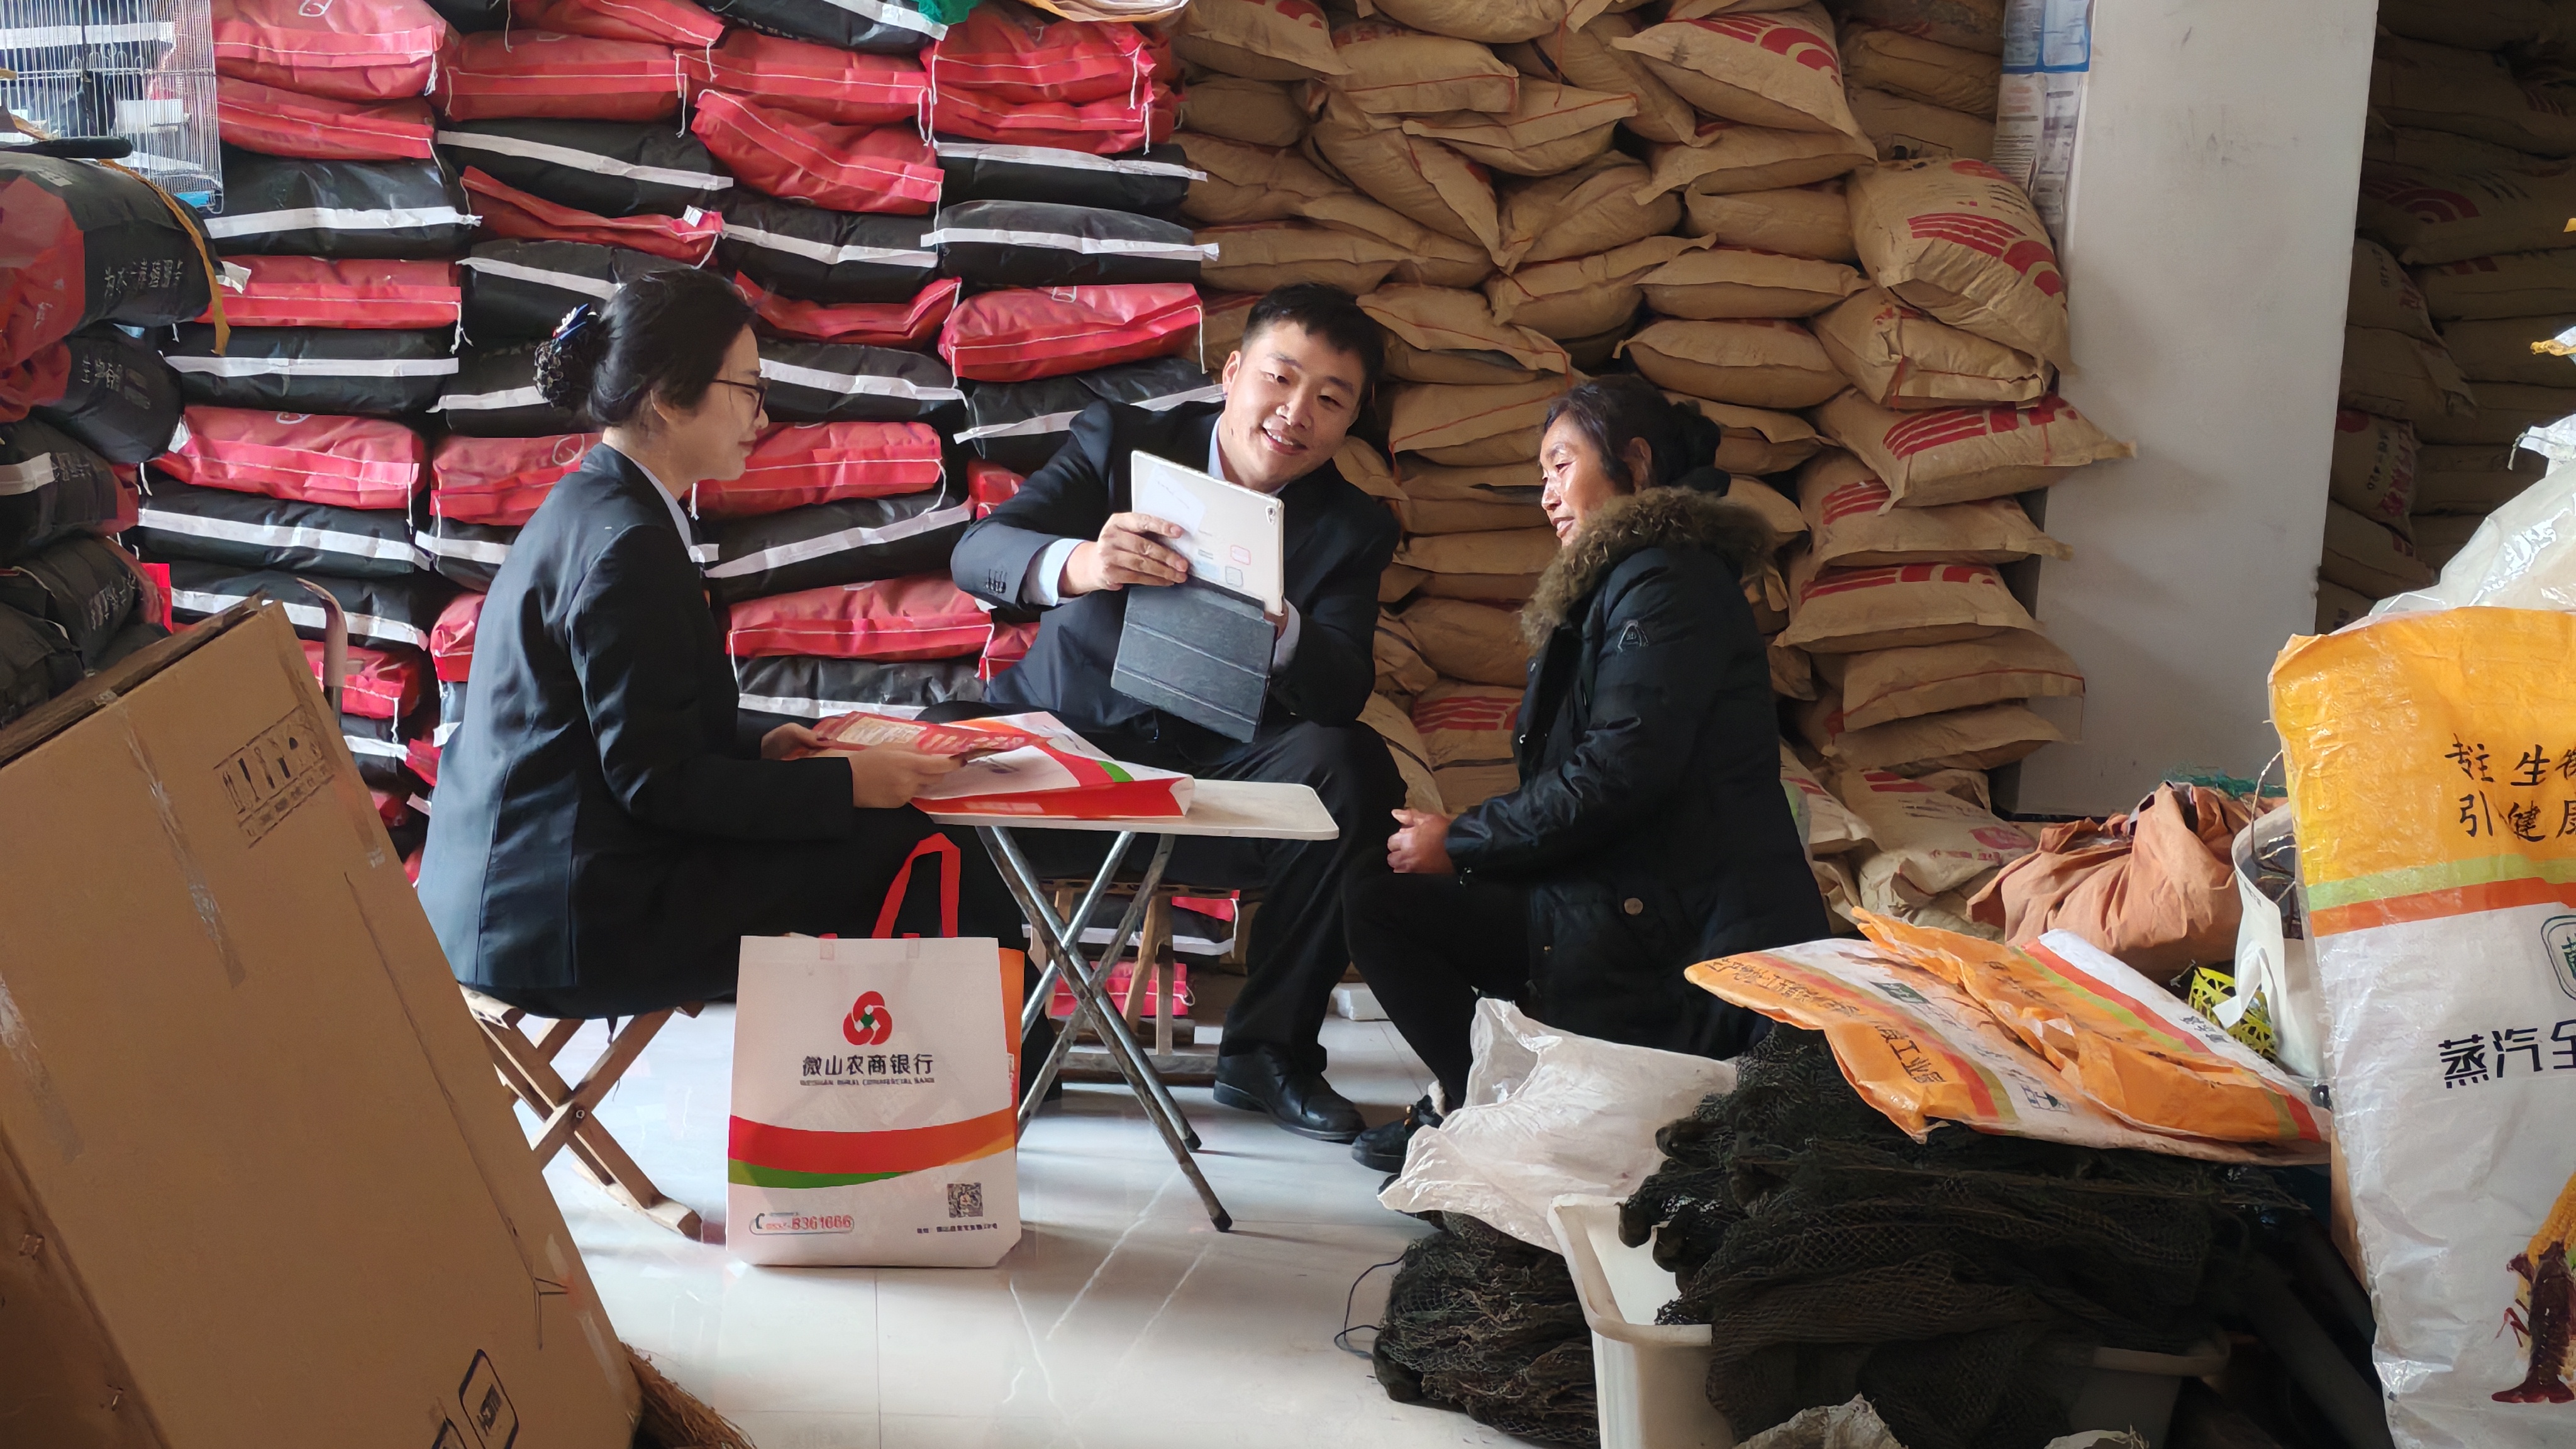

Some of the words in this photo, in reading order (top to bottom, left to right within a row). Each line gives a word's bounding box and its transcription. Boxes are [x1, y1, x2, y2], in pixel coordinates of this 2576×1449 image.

[802, 1053, 934, 1077] 微山农商银行
